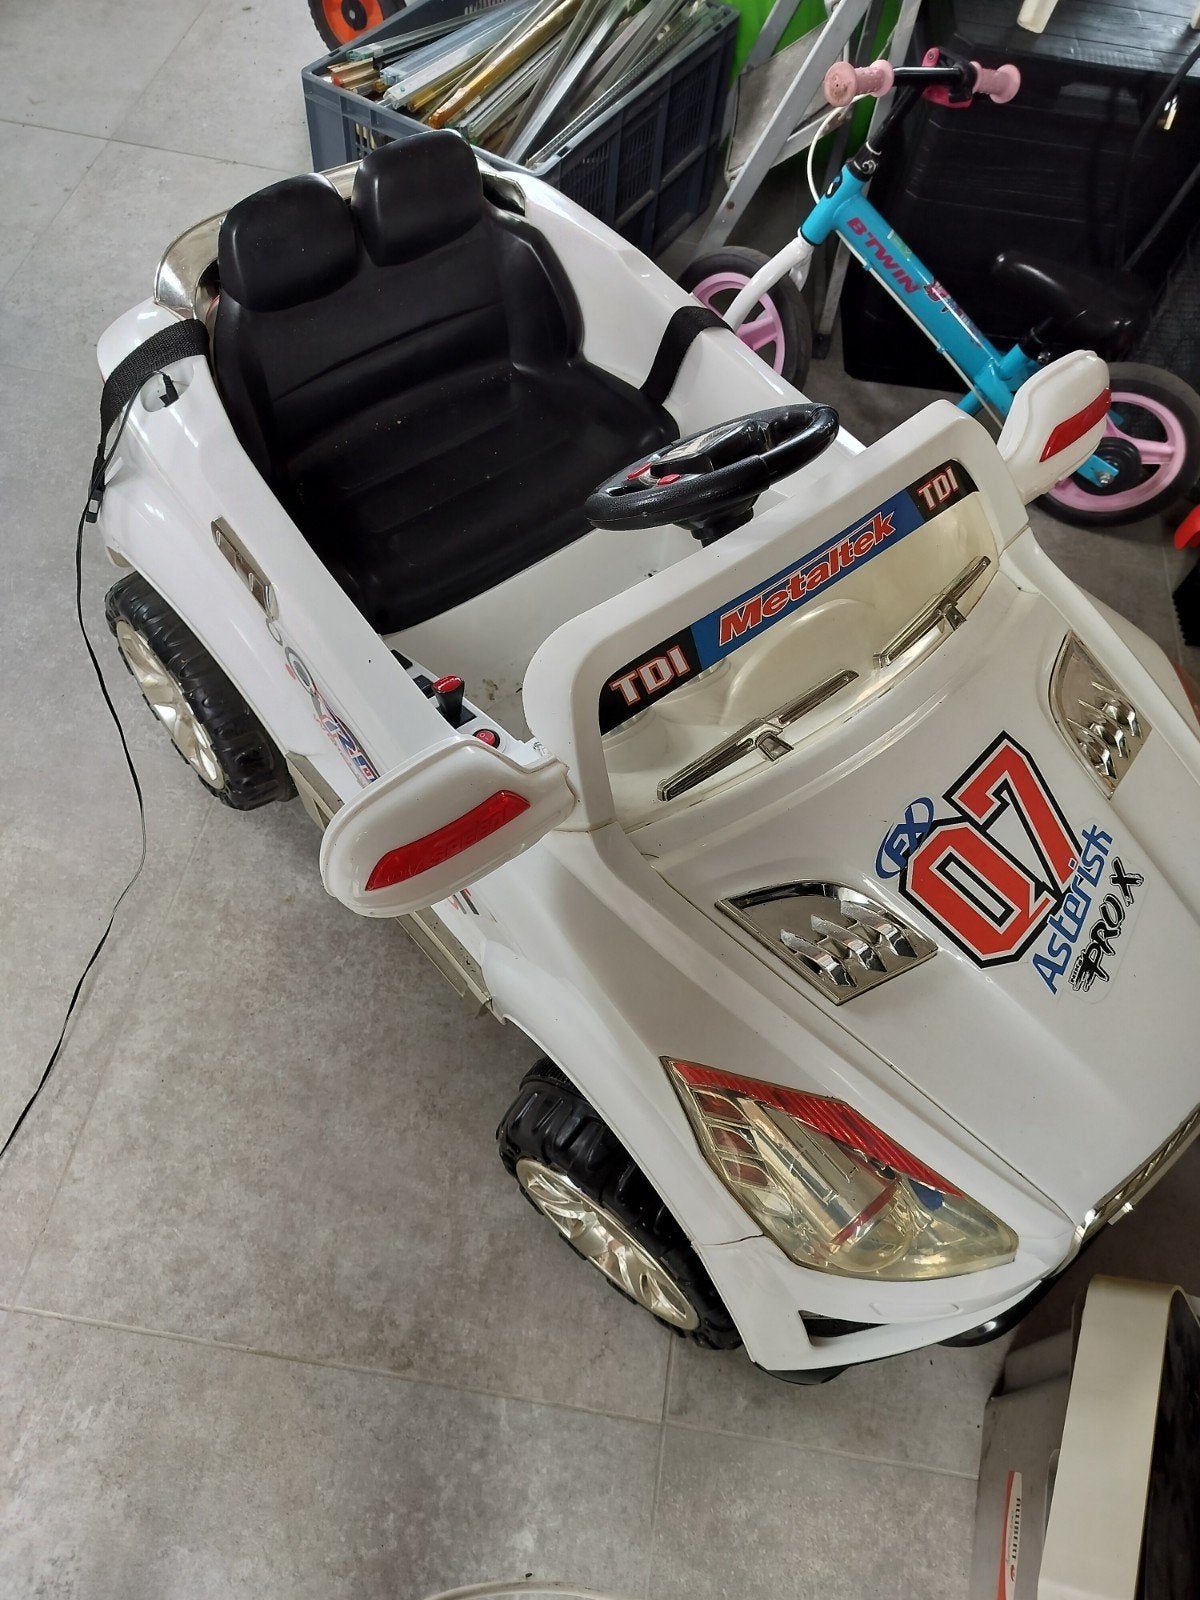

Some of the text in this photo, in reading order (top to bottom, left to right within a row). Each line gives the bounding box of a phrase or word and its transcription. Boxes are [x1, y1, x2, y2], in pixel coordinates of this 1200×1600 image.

[846, 217, 920, 294] B'TWIN
[609, 467, 959, 706] TDI Metaltek TDI
[898, 730, 1083, 969] 07
